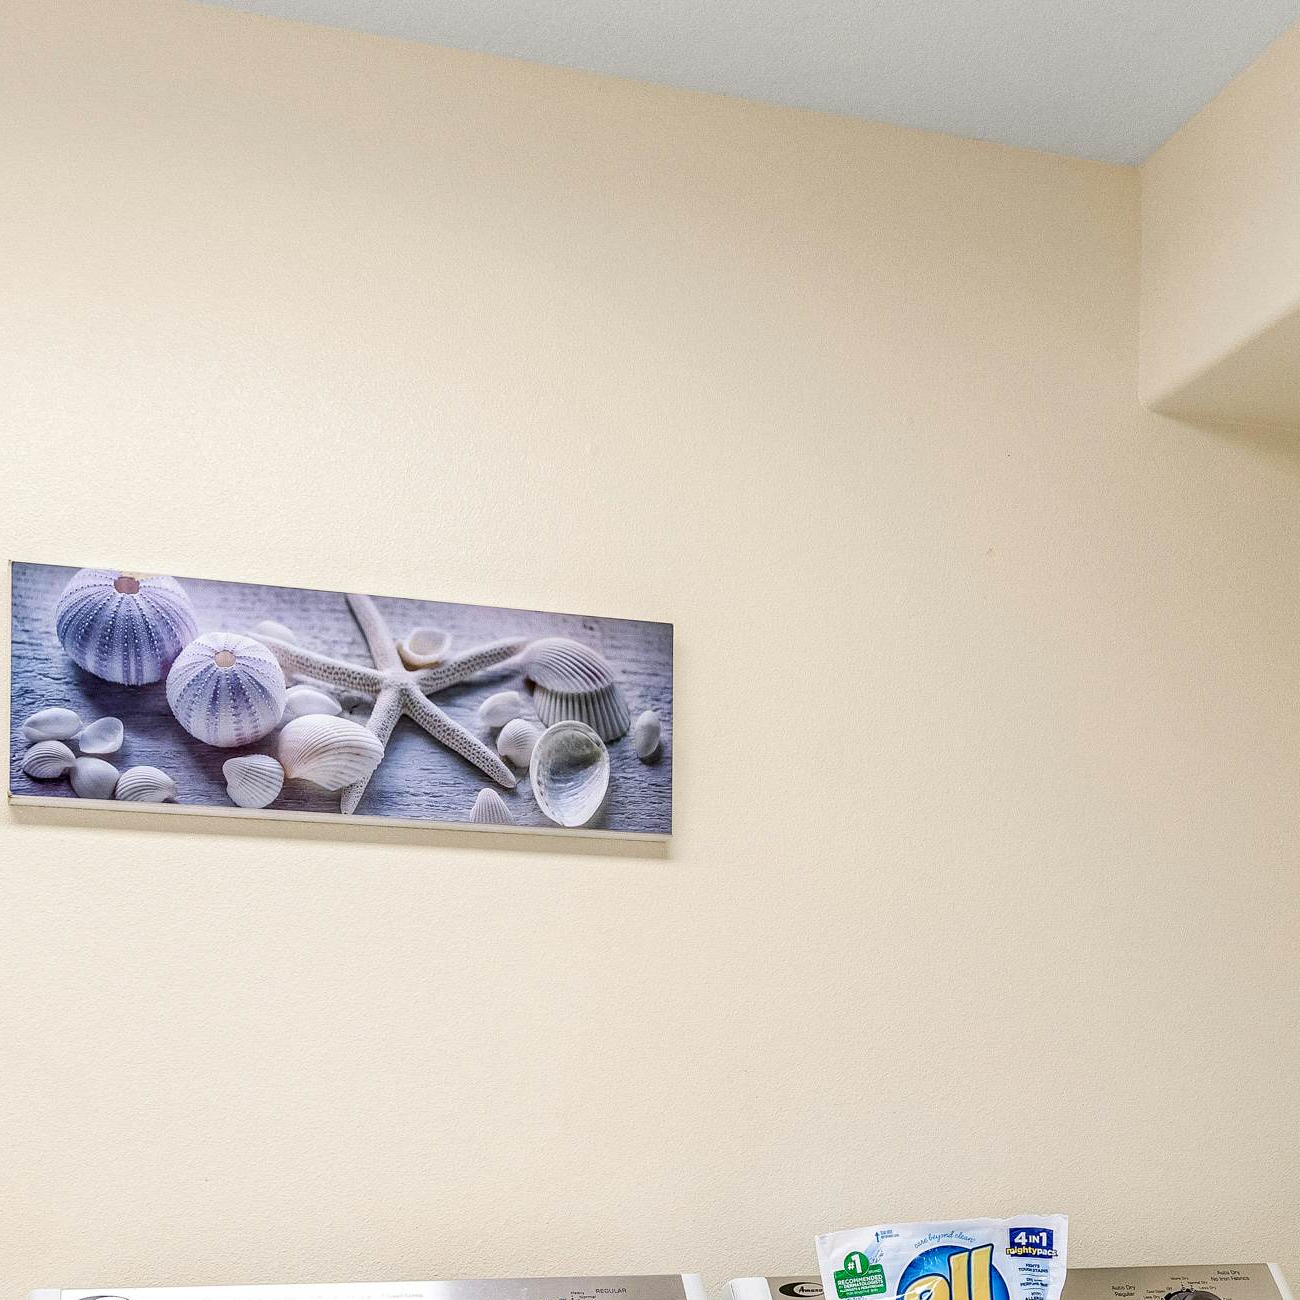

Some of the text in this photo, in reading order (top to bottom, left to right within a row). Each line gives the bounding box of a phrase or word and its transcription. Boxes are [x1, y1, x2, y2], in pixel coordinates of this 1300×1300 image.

[928, 1230, 954, 1243] beyond
[954, 1232, 974, 1243] clean
[1014, 1232, 1047, 1247] 4 IN 1
[837, 1274, 883, 1285] RECOMMENDED
